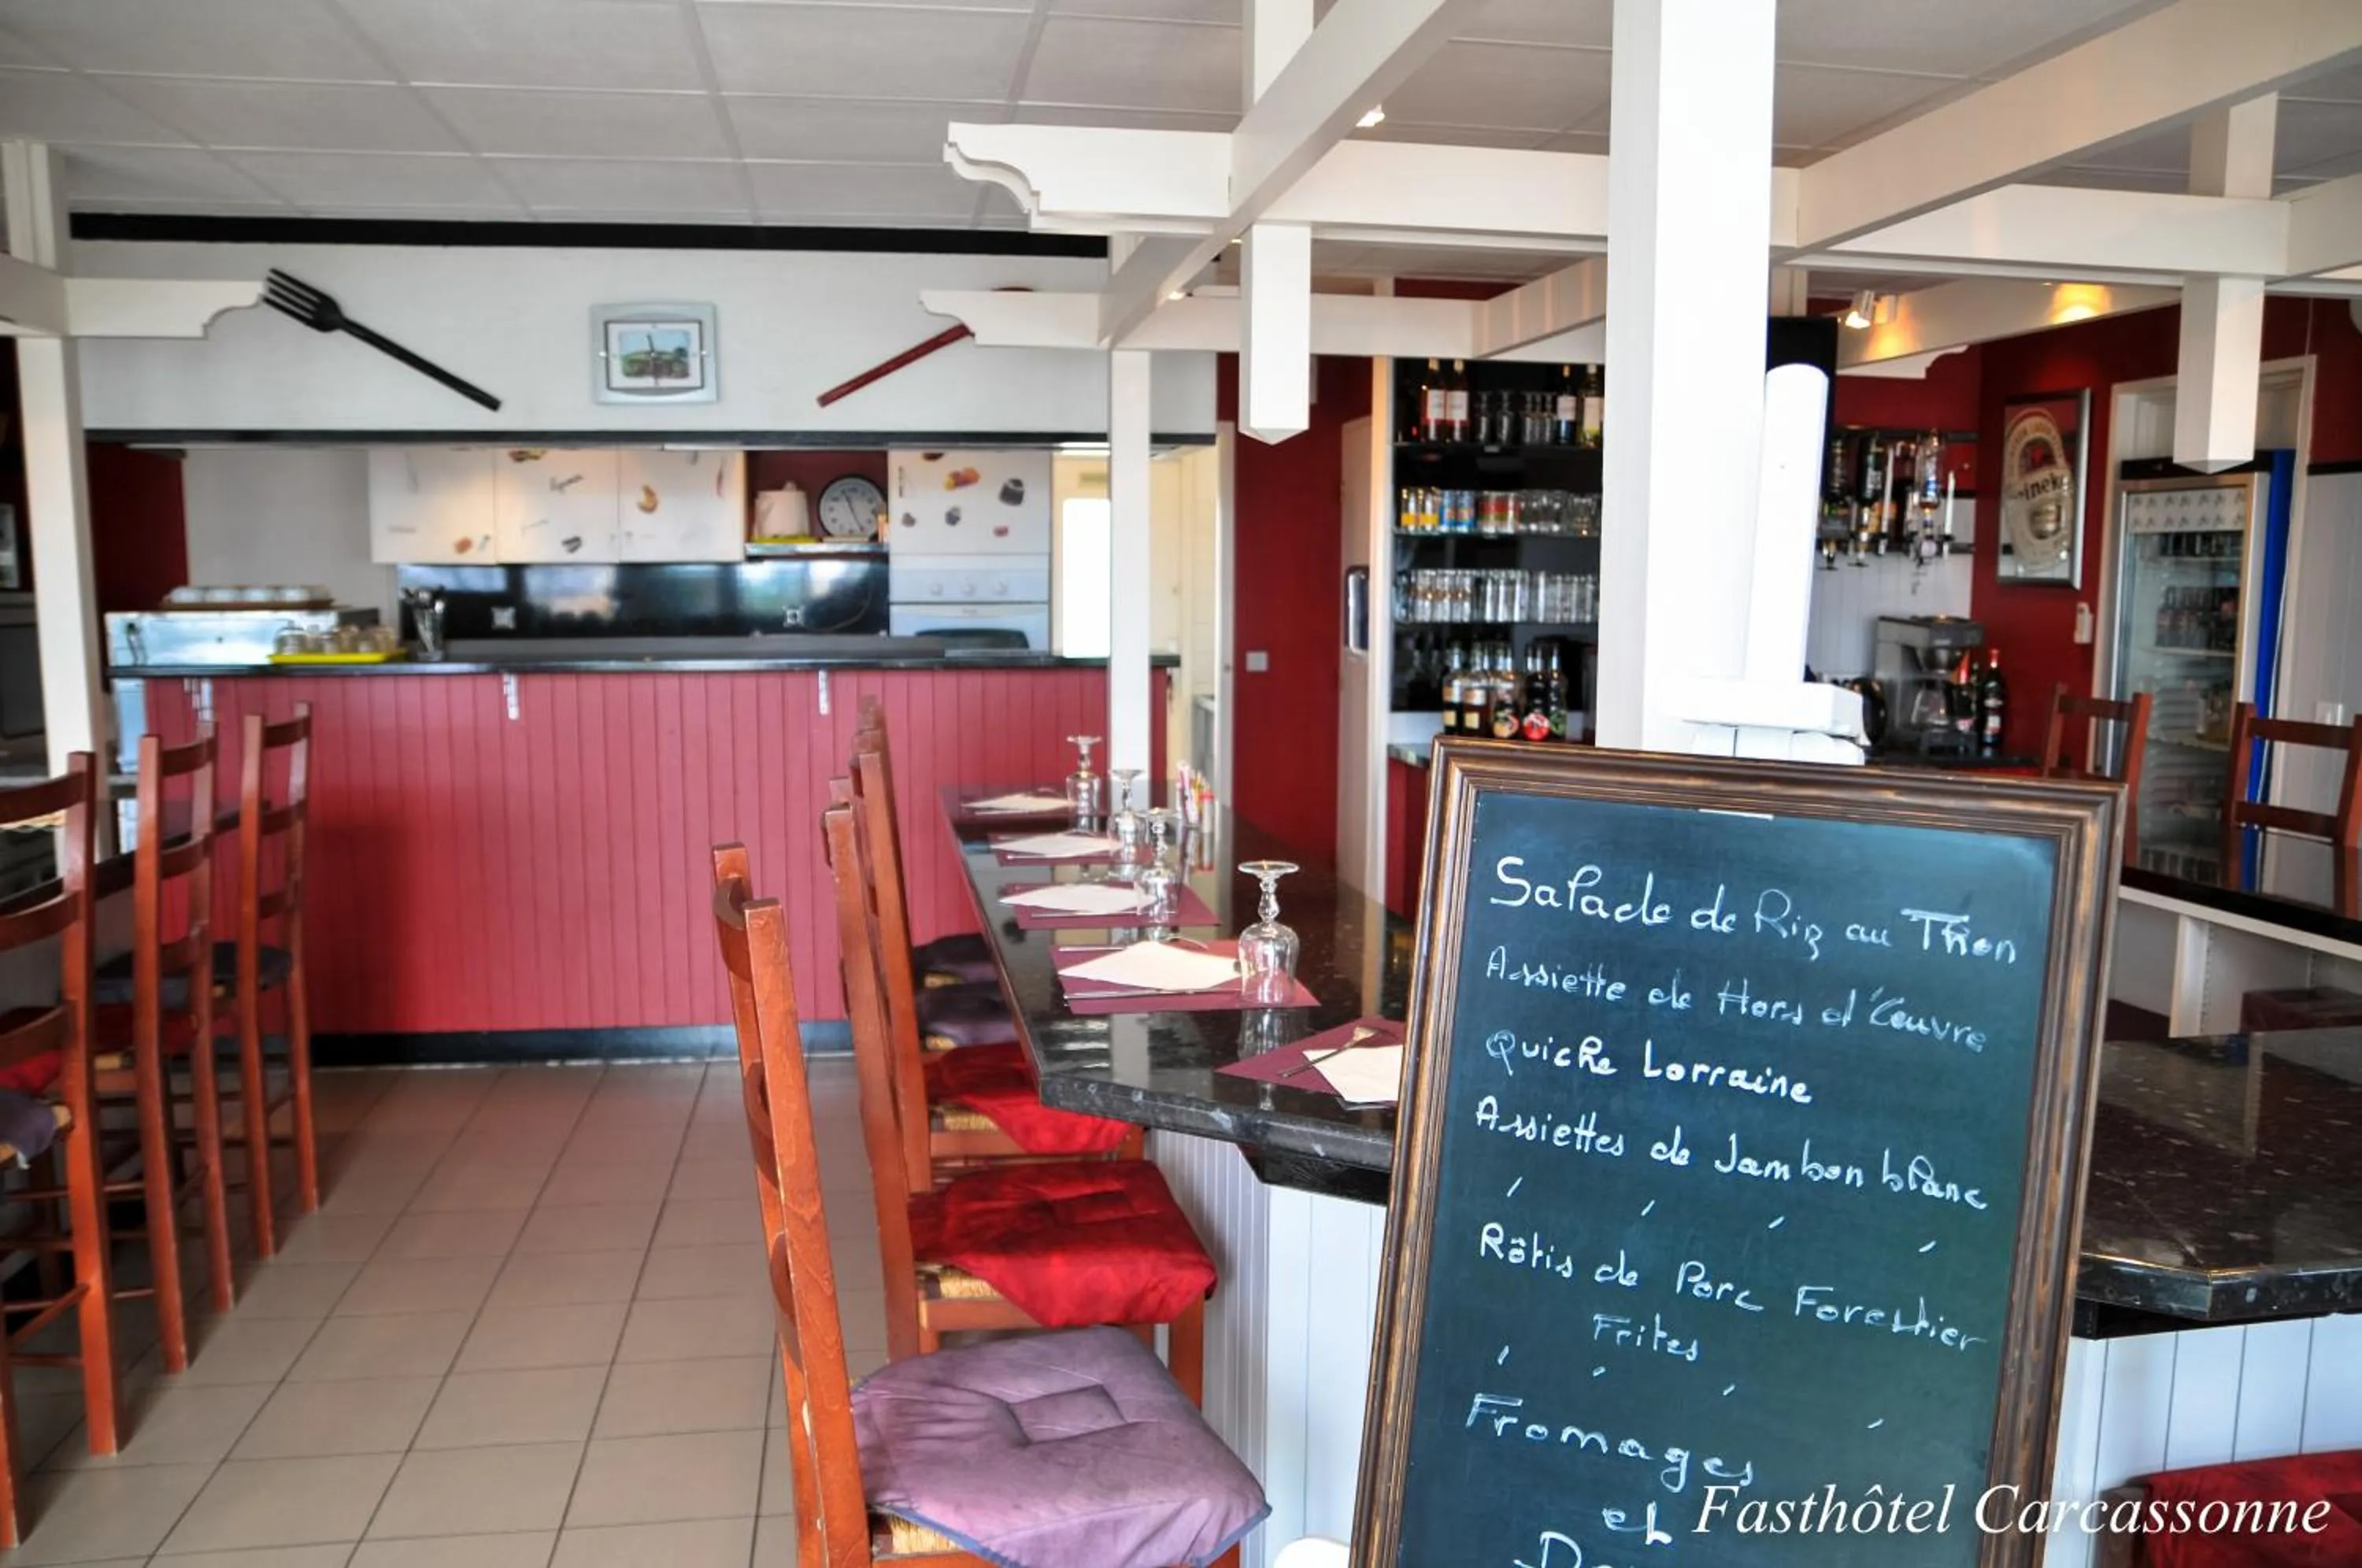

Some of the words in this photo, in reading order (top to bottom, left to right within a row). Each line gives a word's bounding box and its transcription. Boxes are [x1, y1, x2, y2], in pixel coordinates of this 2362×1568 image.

[1490, 855, 1673, 926] Salade
[1690, 883, 1737, 934] de
[1845, 923, 1893, 948] au
[1900, 908, 2016, 964] Thon
[1486, 945, 1627, 1002] Assiette
[1647, 967, 1692, 1011] de
[1716, 977, 1804, 1026] Hors
[1485, 1030, 1619, 1077] Quiche
[1642, 1038, 1812, 1104] Lorraine
[1475, 1095, 1625, 1157] Assiettes
[1649, 1124, 1690, 1167] de
[1881, 1147, 1988, 1210] blanc
[1593, 1312, 1699, 1362] Frites
[1594, 1248, 1638, 1288] de
[1675, 1260, 1764, 1312] Porc
[1794, 1284, 1988, 1352] Forestier
[1465, 1392, 1754, 1493] Fromages
